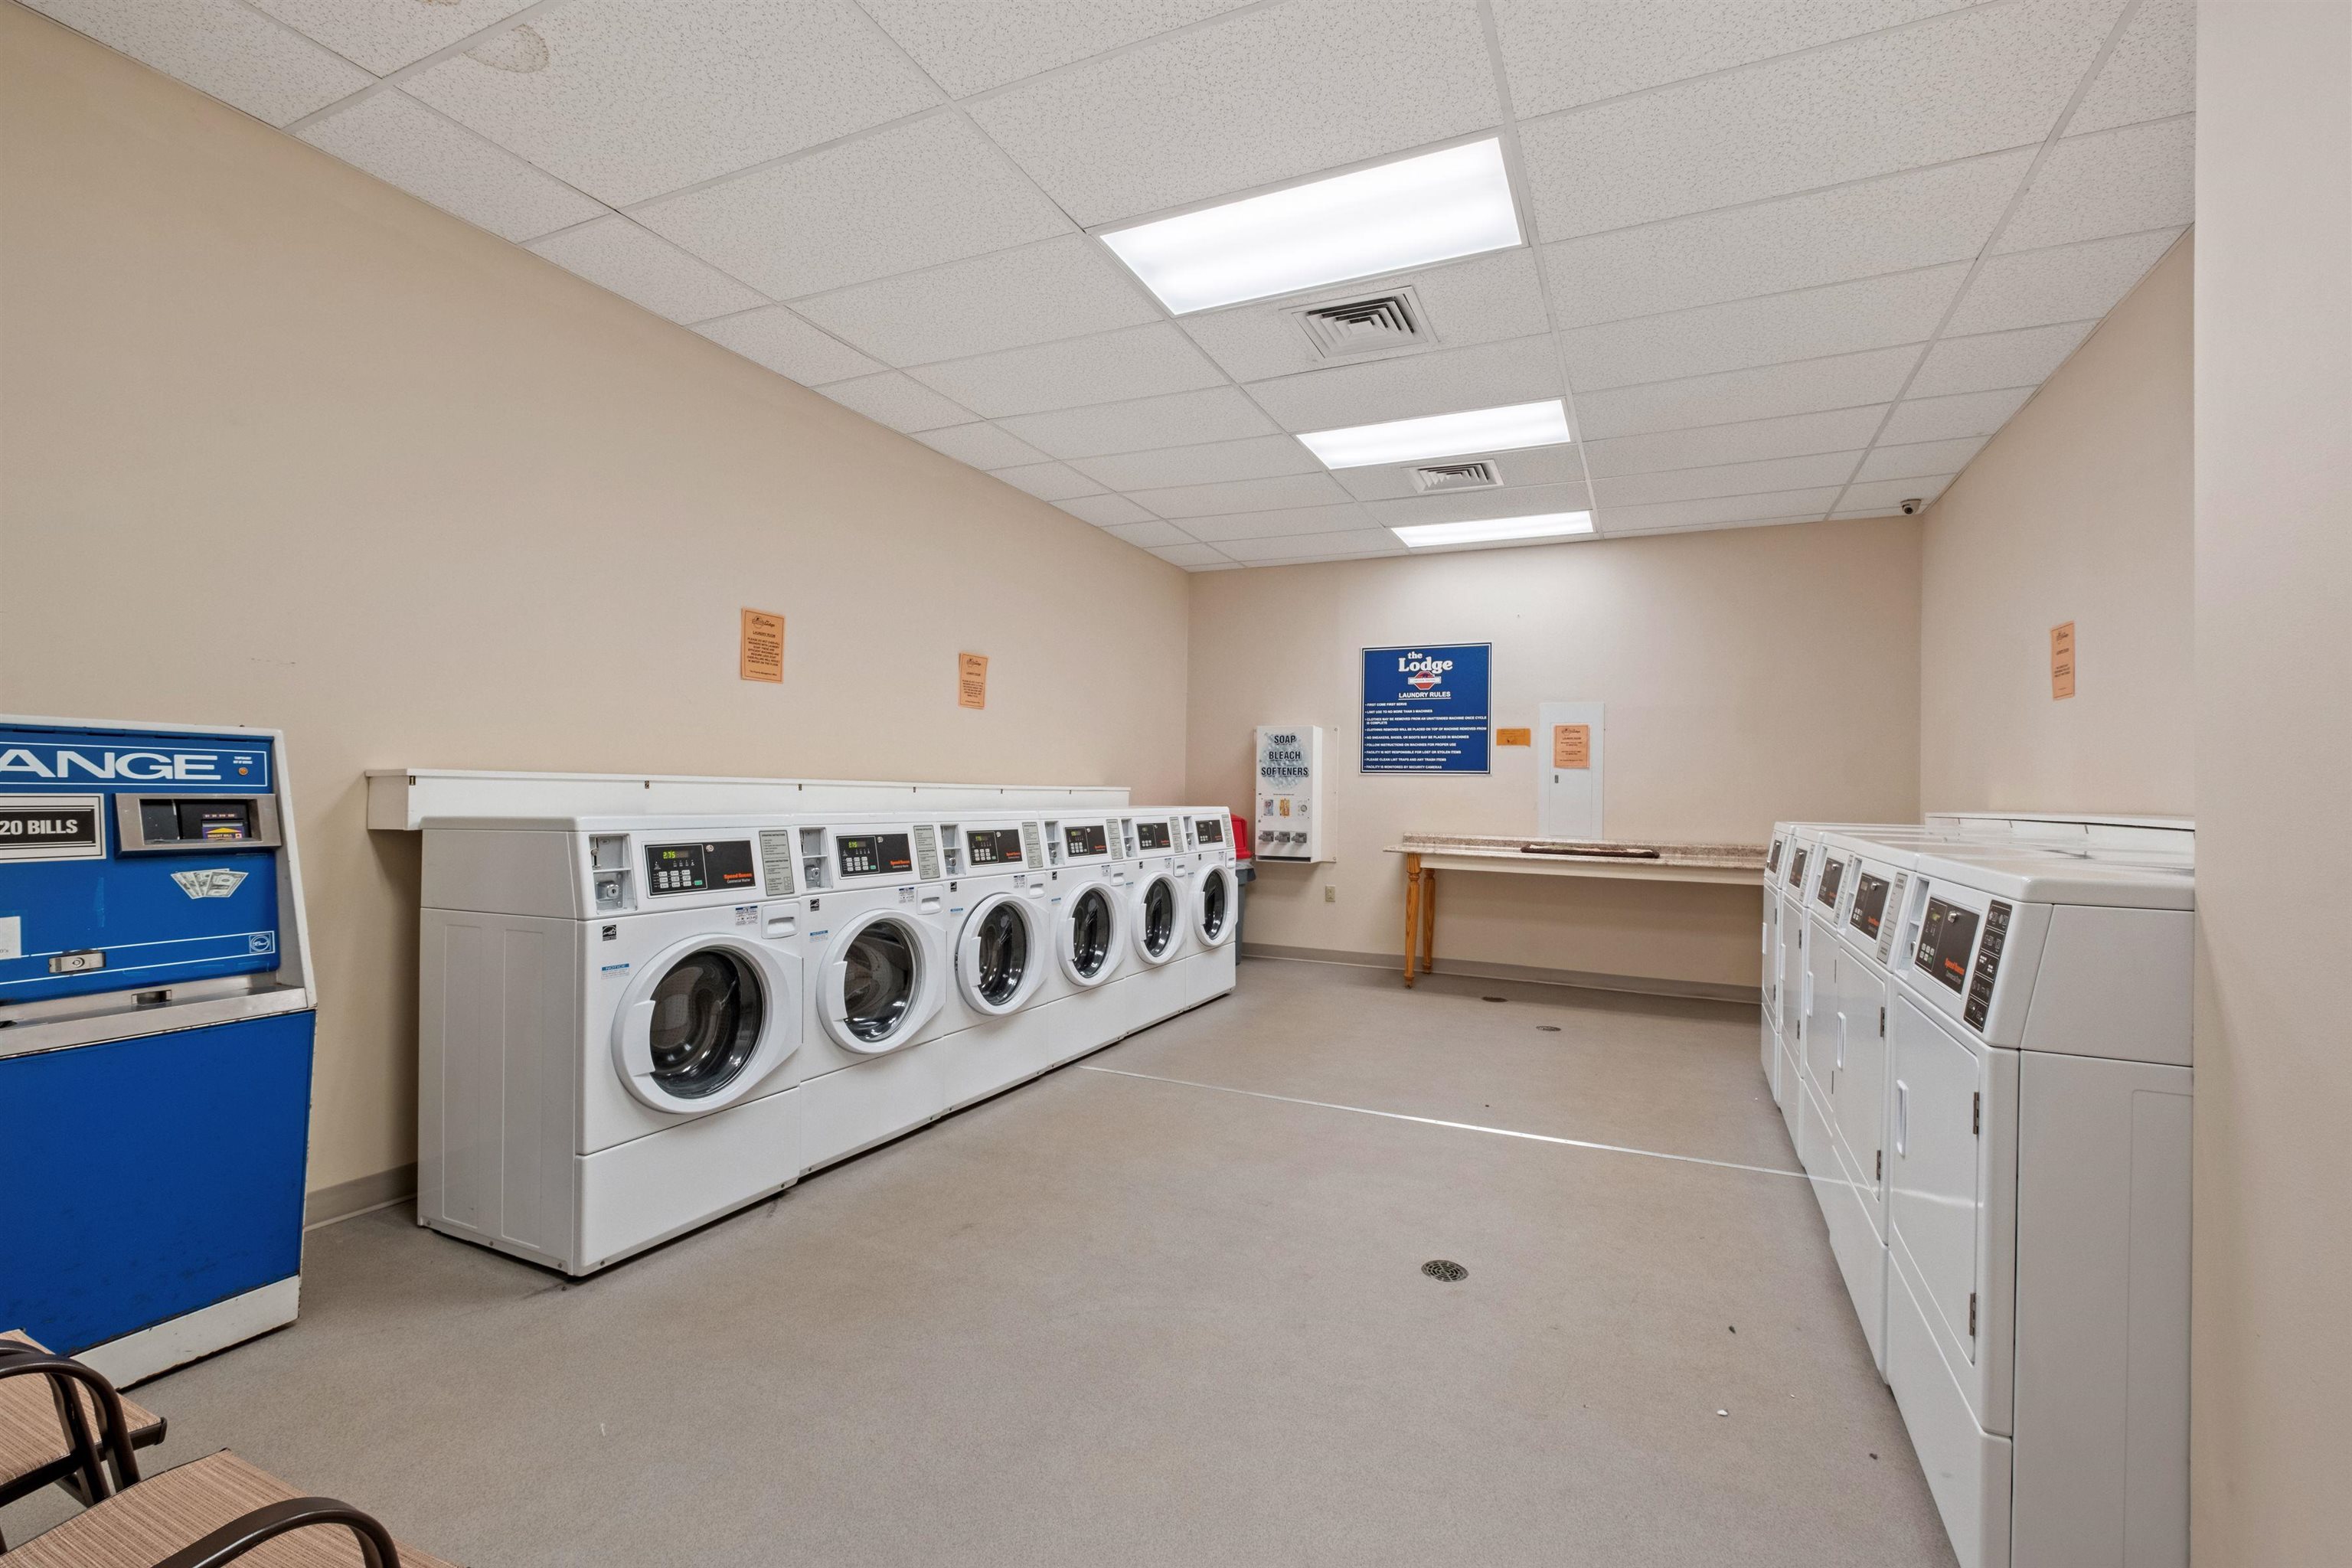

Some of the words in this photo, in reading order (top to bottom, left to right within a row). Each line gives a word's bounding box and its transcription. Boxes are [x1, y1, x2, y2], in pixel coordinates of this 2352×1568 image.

[1398, 656, 1453, 674] Lodge
[1274, 735, 1297, 744] SOAP
[1269, 751, 1301, 760] BLEACH
[0, 749, 221, 780] ANGE
[1261, 766, 1308, 776] SOFTENERS
[27, 819, 78, 835] BILLS
